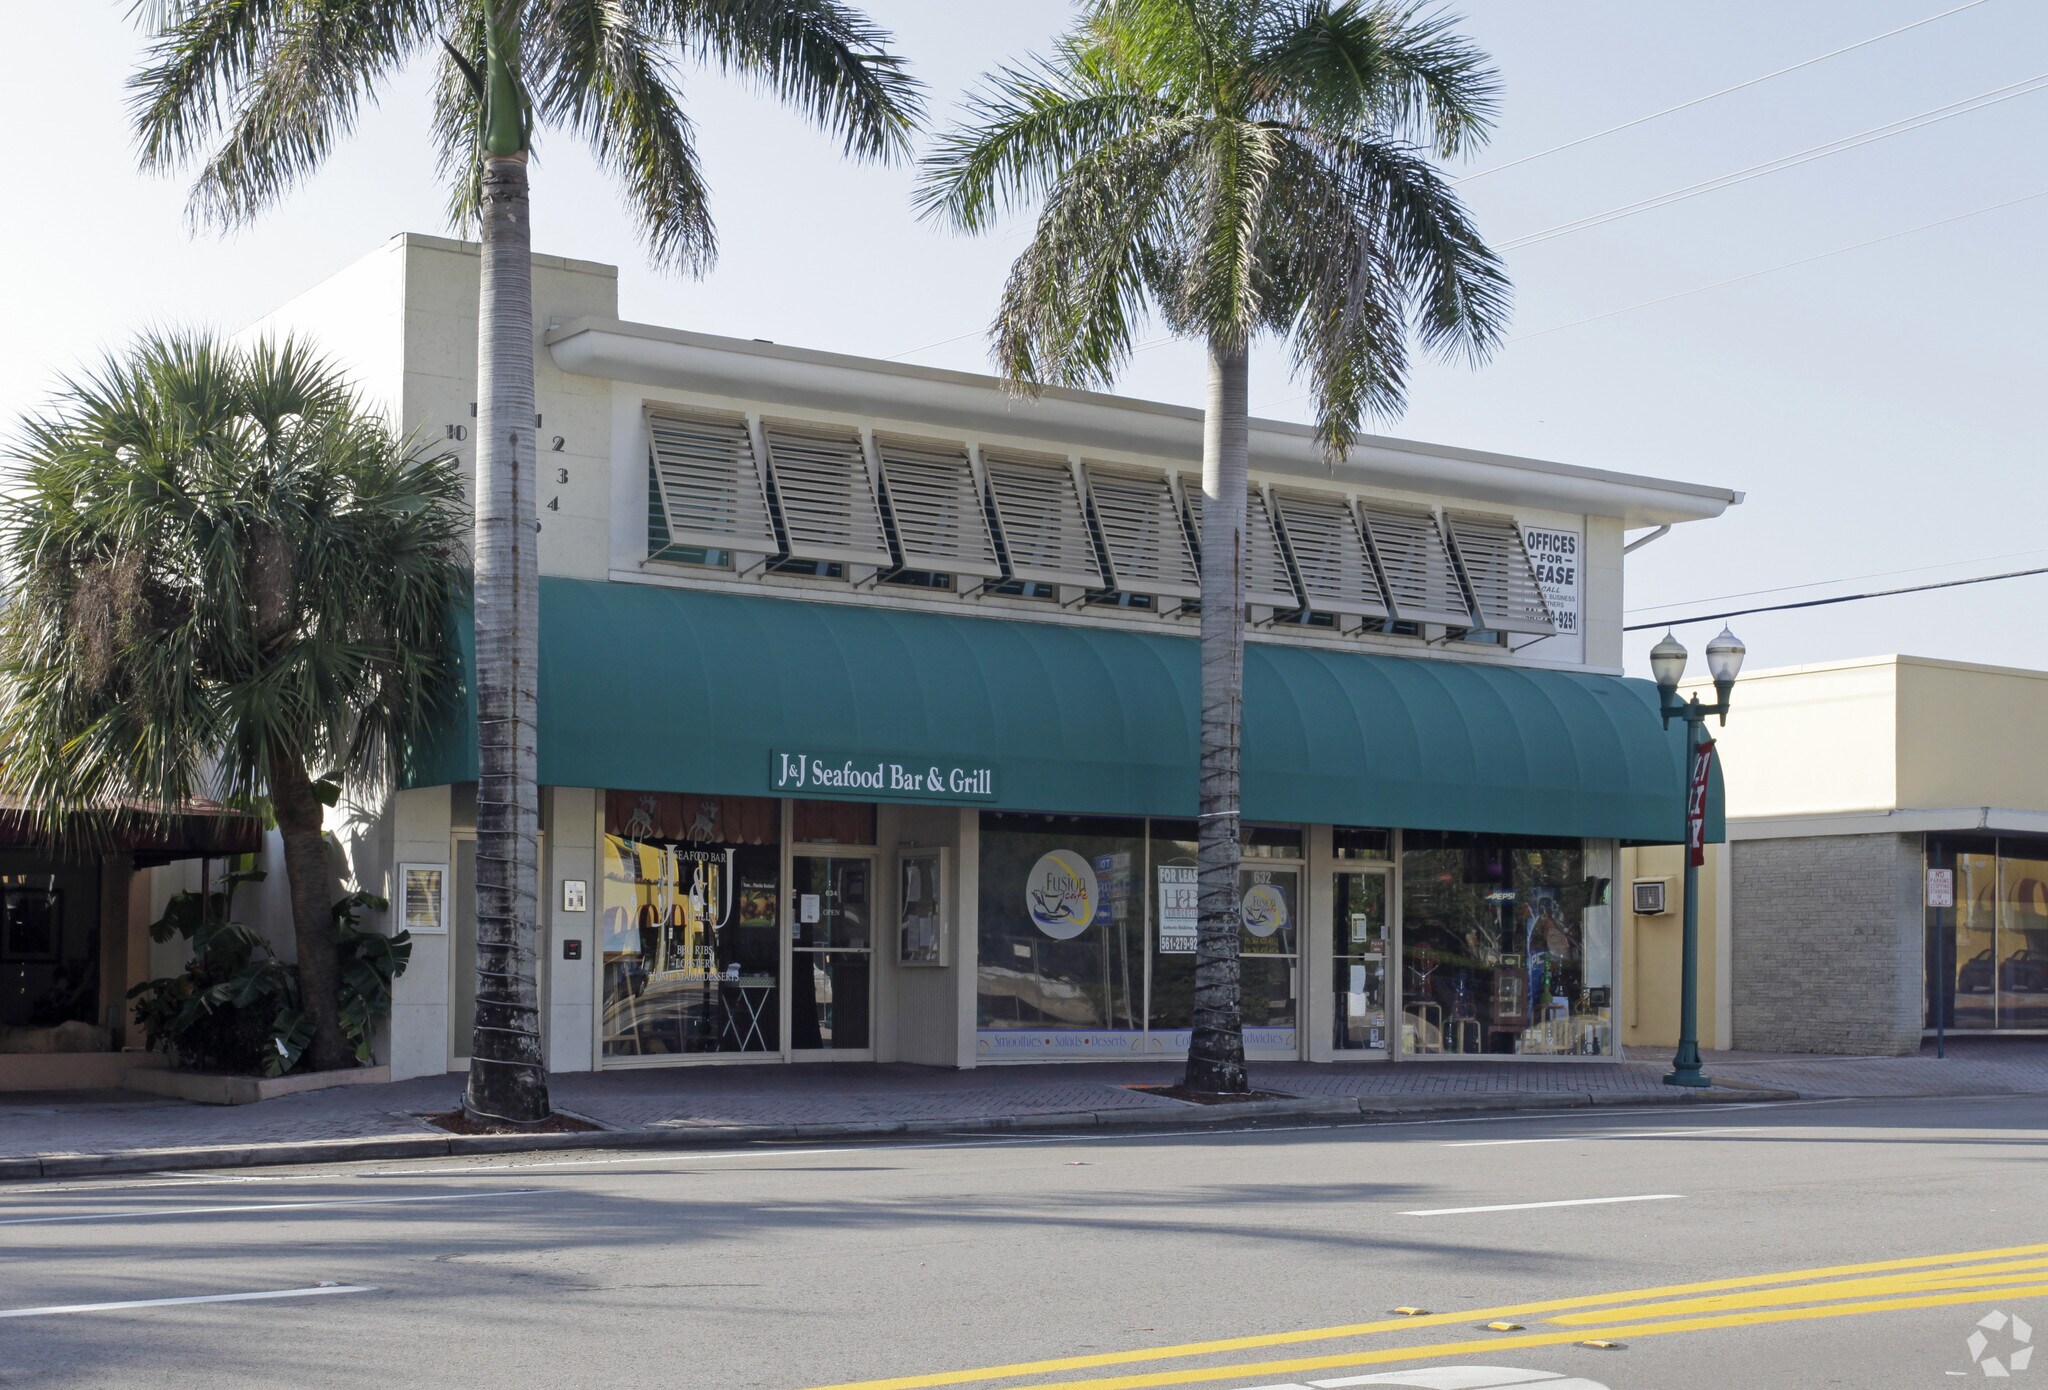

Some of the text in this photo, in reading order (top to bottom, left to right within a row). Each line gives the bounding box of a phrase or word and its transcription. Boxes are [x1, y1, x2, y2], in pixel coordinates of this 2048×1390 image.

[444, 424, 468, 442] 10
[552, 435, 565, 453] 2
[556, 467, 569, 484] 3
[546, 495, 560, 512] 4
[1527, 531, 1576, 555] OFFICES
[1540, 552, 1563, 564] FOR
[1536, 564, 1575, 586] EASE
[1541, 585, 1561, 593] CALL
[1549, 593, 1576, 603] BUSINESS
[811, 759, 885, 789] Seafood
[889, 763, 924, 791] Bar
[926, 766, 946, 792] &
[949, 768, 992, 794] Grill
[674, 849, 727, 863] SEAFOOD BAR
[1046, 872, 1086, 892] Fusion
[1159, 868, 1198, 883] FOR LEAS
[1253, 871, 1272, 884] 632
[652, 844, 679, 928] J
[712, 848, 737, 929] J
[1491, 892, 1516, 900] PEPSI
[695, 945, 713, 955] RIBS
[703, 971, 740, 982] DESSERTS
[994, 1034, 1127, 1048] Smoothies Salads Desserts
